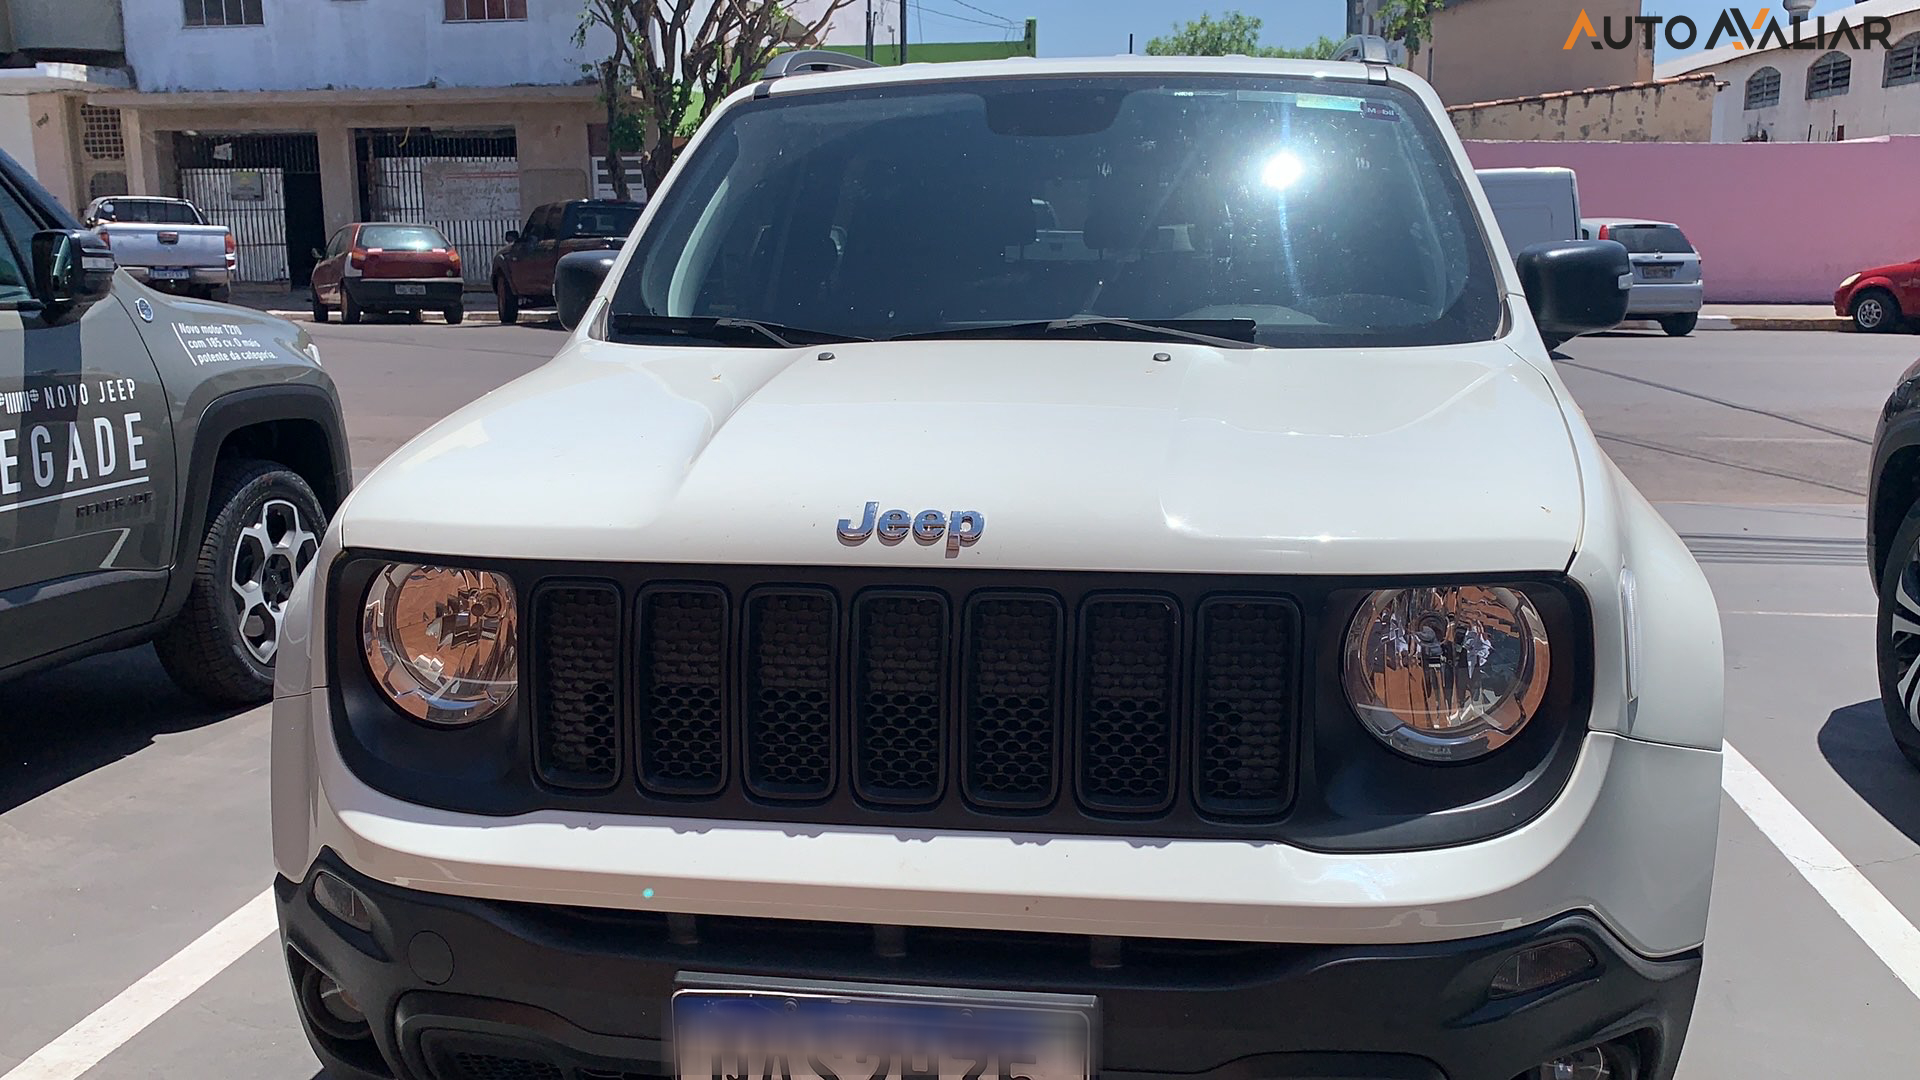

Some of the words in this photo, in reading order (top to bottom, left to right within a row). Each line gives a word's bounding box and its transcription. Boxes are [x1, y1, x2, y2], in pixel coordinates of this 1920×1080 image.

[178, 322, 200, 335] Novo
[200, 324, 222, 335] motor
[222, 324, 242, 336] T270
[187, 339, 207, 349] com
[205, 337, 223, 348] 185
[197, 351, 230, 366] potente
[230, 350, 241, 361] da
[43, 383, 89, 410] NOVO
[99, 378, 136, 403] JEEP
[836, 500, 985, 559] Jeep
